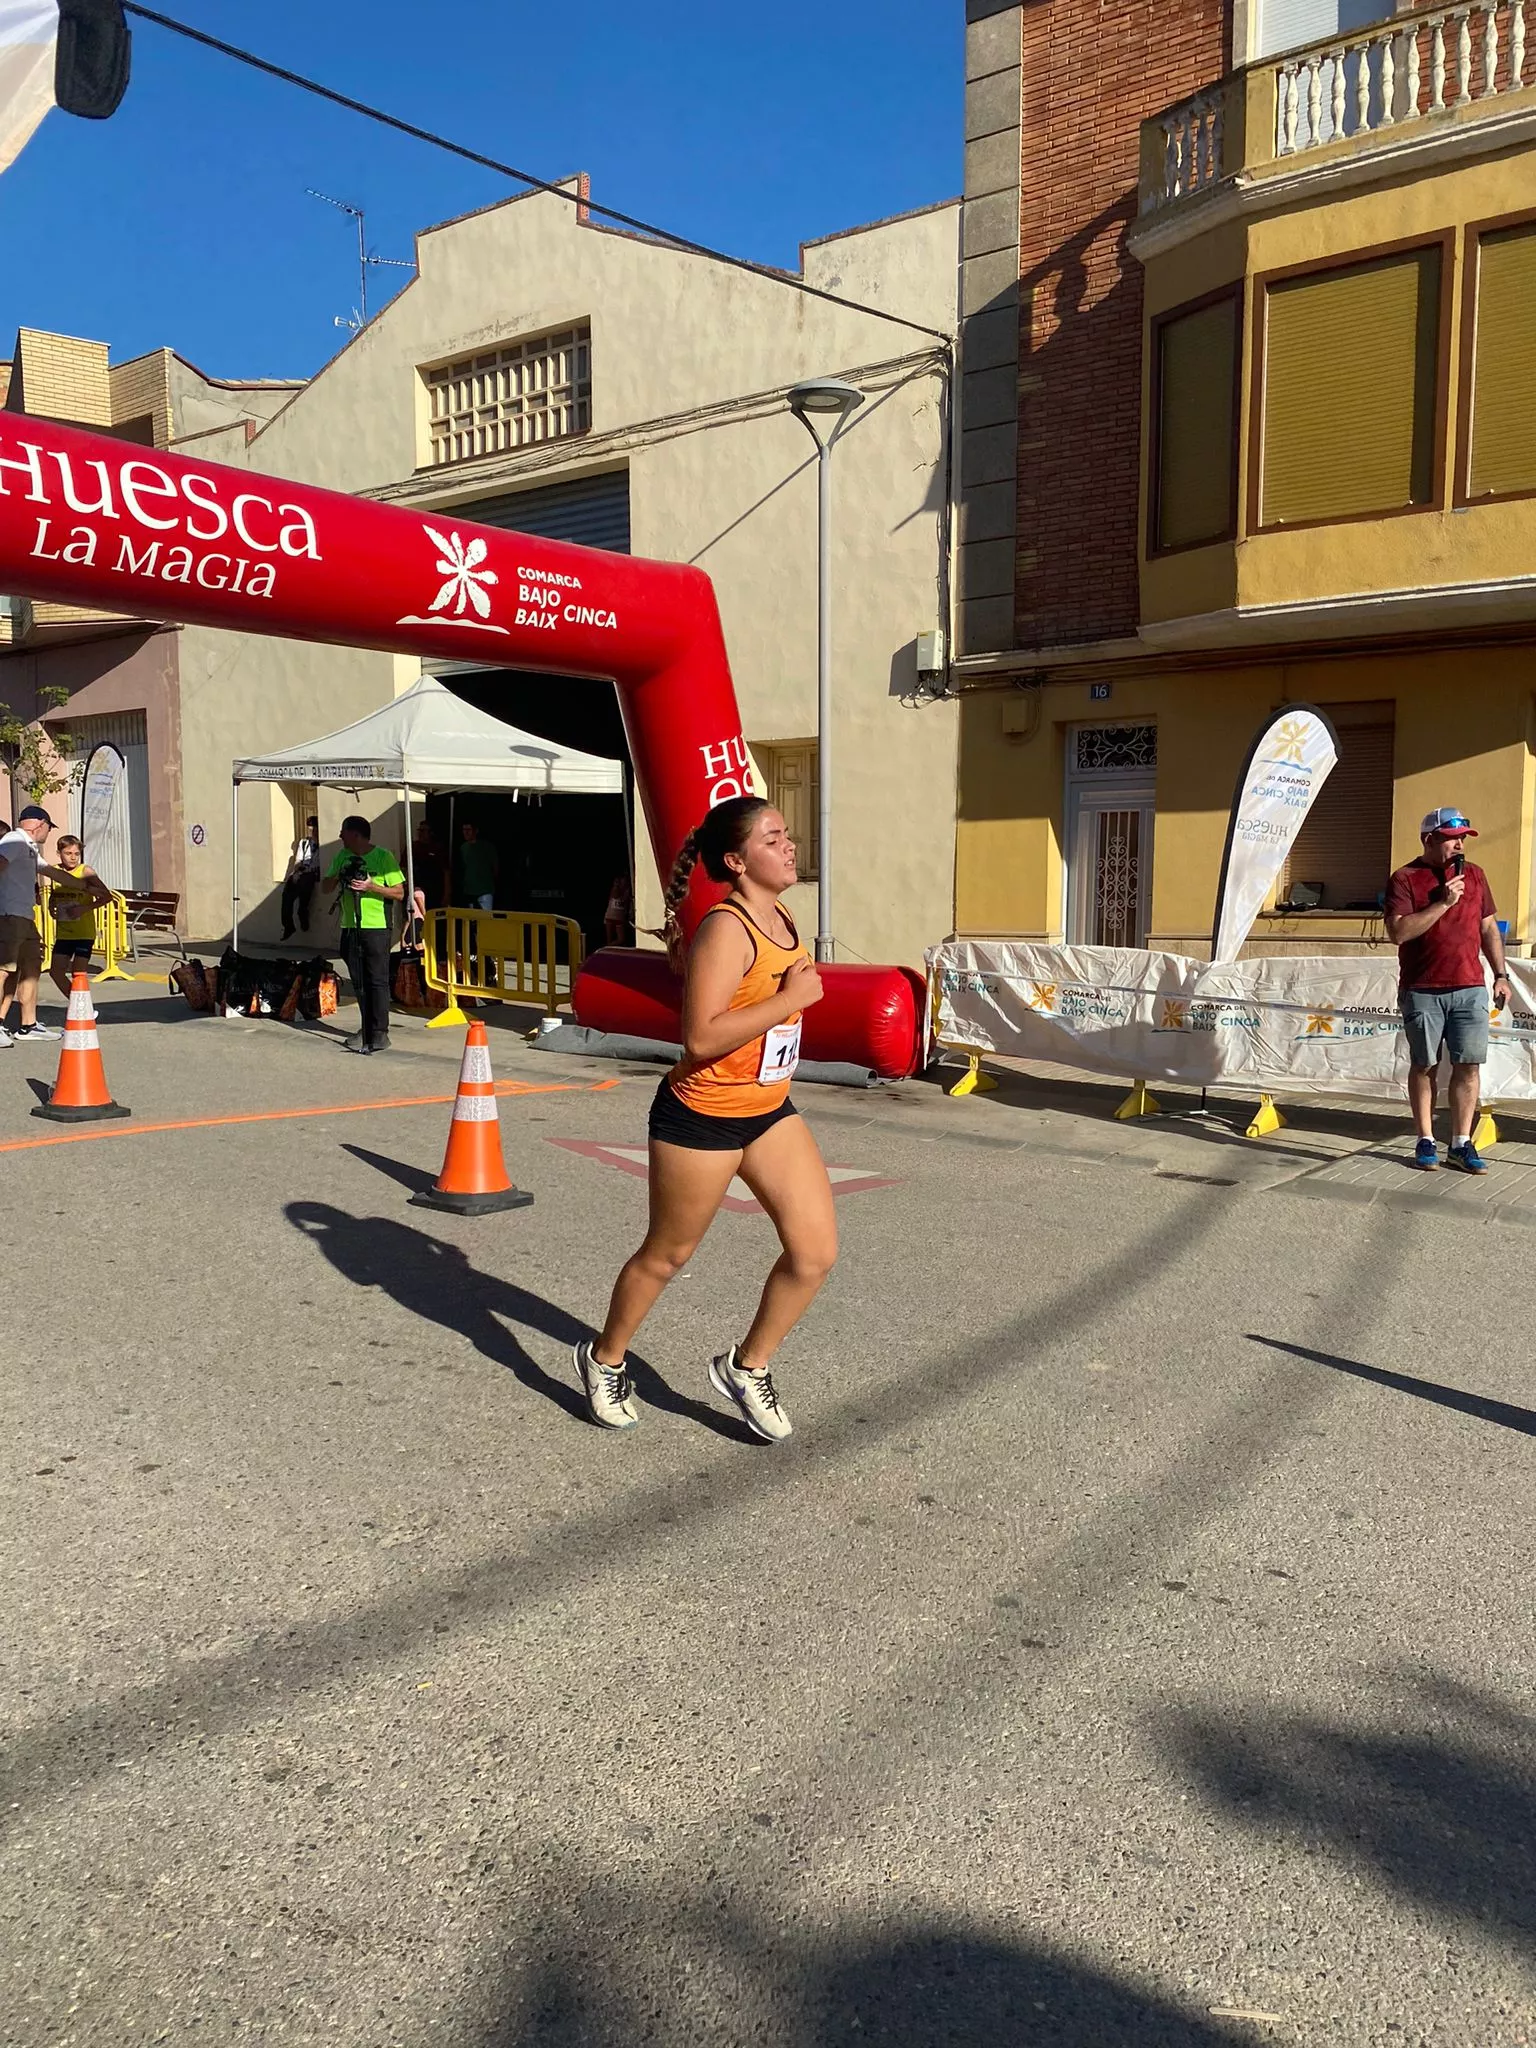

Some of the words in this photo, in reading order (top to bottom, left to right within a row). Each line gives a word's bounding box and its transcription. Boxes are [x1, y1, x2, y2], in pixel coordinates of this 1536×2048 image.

[29, 517, 98, 567] La
[517, 566, 582, 590] COMARCA
[519, 584, 561, 609] BAJO
[514, 607, 559, 630] BAIX
[563, 604, 617, 629] CINCA
[1095, 685, 1107, 698] 16
[968, 982, 999, 994] CINCA
[1062, 989, 1100, 1000] COMARCA
[1062, 997, 1087, 1008] BAJO
[1191, 1003, 1232, 1012] COMARCA
[1061, 1007, 1085, 1018] BAIX
[1088, 1005, 1124, 1017] CINCA
[1192, 1011, 1217, 1022] BAJO
[1343, 1006, 1390, 1015] COMARCA
[1192, 1021, 1217, 1032] BAIX
[1220, 1017, 1260, 1028] CINCA
[1344, 1026, 1374, 1036] BAIX
